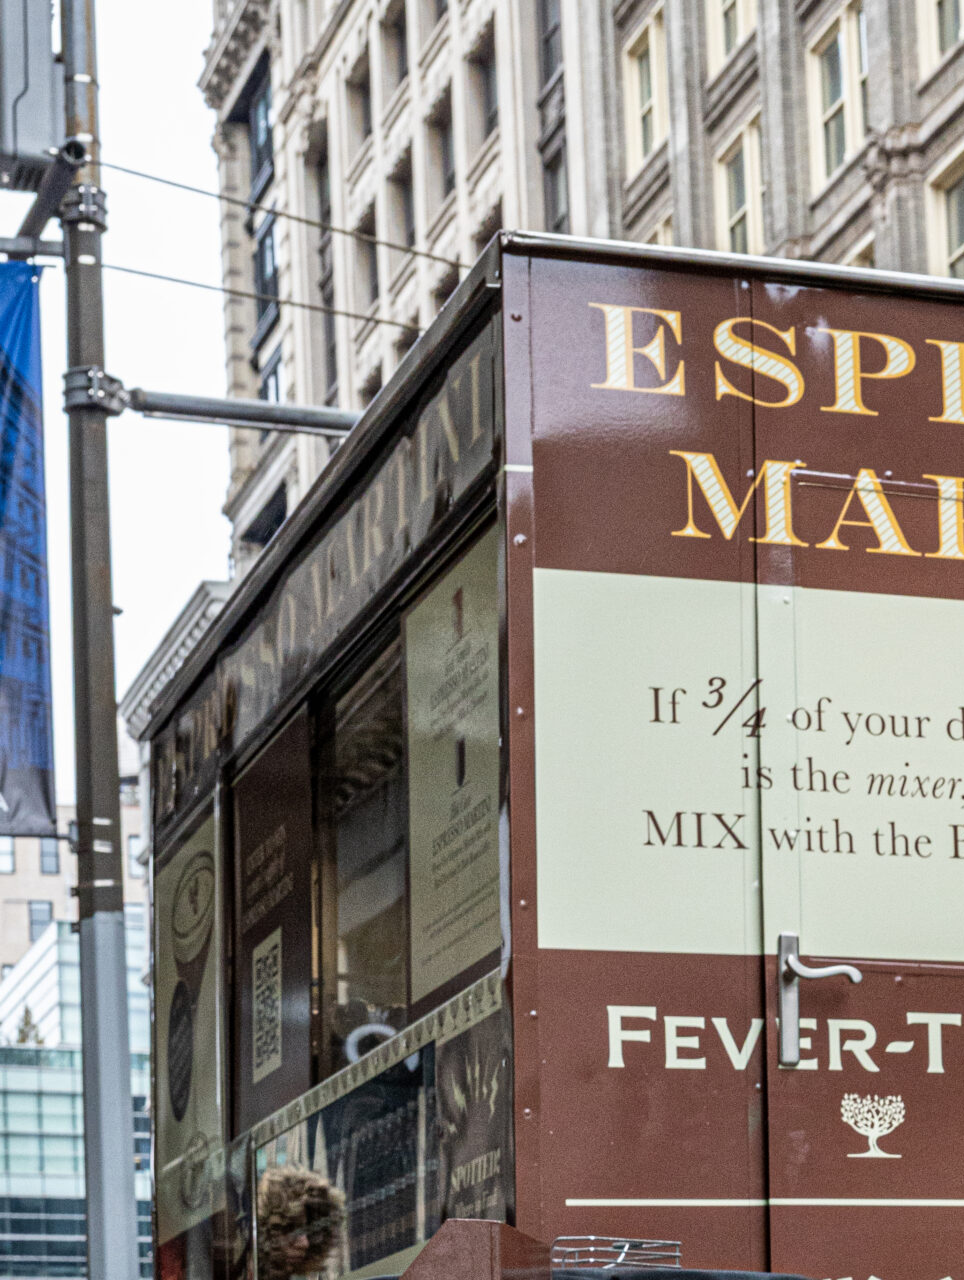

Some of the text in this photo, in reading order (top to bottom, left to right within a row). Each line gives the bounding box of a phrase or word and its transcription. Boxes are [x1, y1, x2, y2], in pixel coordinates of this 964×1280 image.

[647, 686, 685, 725] If
[791, 696, 832, 731] of
[840, 711, 932, 746] your
[740, 753, 774, 789] is
[790, 756, 852, 795] the
[643, 810, 750, 851] MIX
[769, 813, 857, 857] with
[872, 820, 933, 859] the
